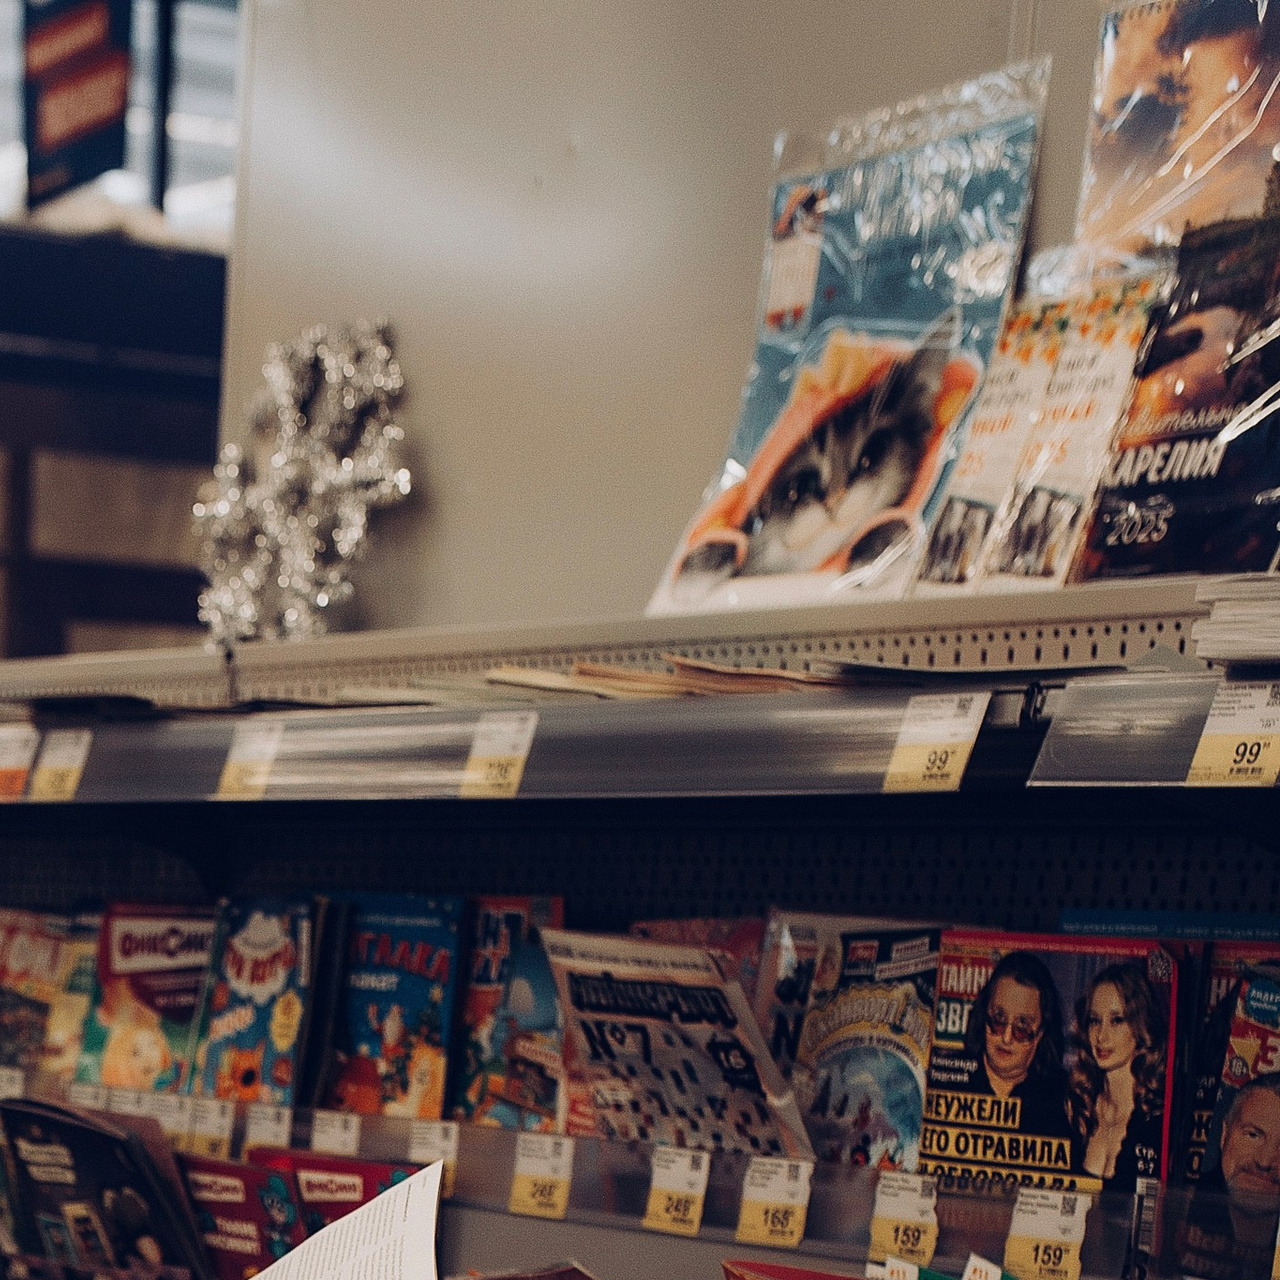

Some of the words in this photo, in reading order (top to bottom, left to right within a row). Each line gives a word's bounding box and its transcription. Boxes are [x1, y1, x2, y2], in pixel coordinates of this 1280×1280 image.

[923, 1127, 949, 1151] ЕГО
[955, 1131, 1069, 1168] ОТРАВИЛА
[893, 1226, 921, 1247] 159
[1033, 1244, 1064, 1267] 159
